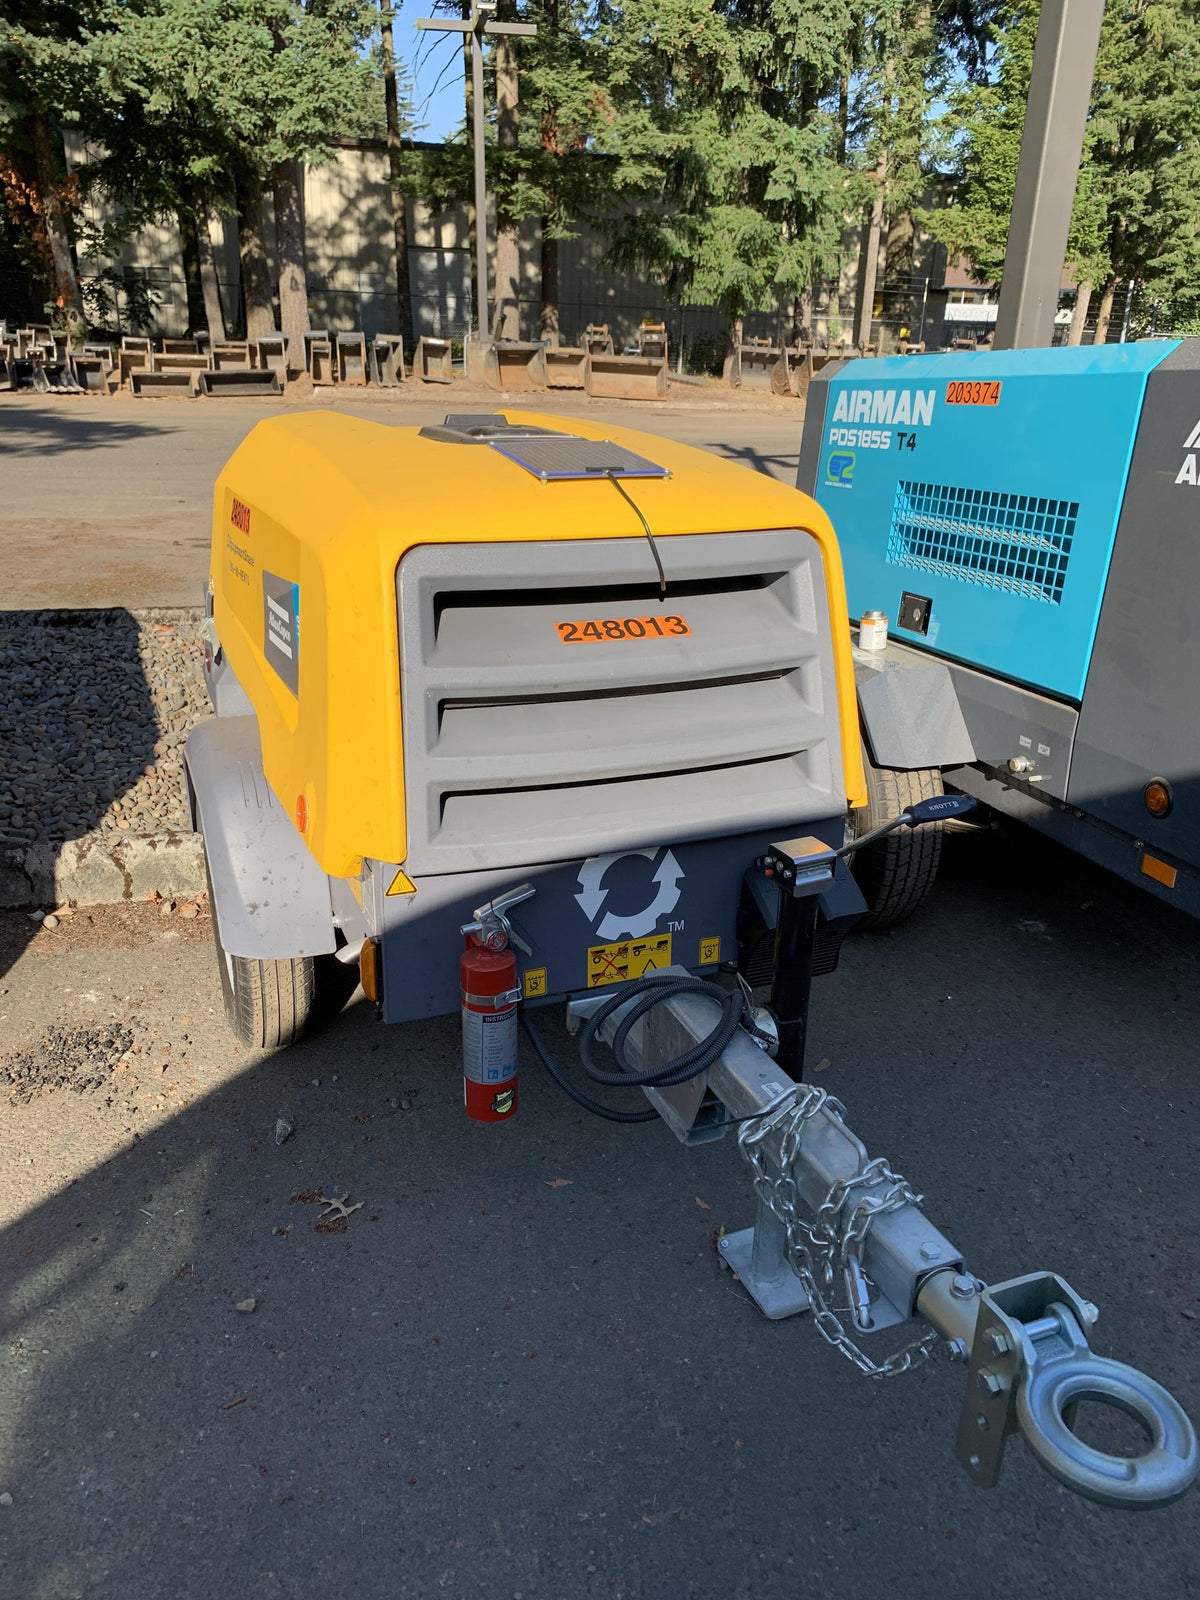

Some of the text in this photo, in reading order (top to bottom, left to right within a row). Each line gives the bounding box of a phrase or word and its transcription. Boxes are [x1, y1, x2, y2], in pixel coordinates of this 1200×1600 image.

[946, 382, 999, 403] 203374
[832, 390, 936, 426] AIRMAN
[829, 428, 917, 451] PDS185S T4
[558, 616, 688, 642] 248013
[928, 801, 952, 811] KNOTT
[667, 919, 685, 932] TM
